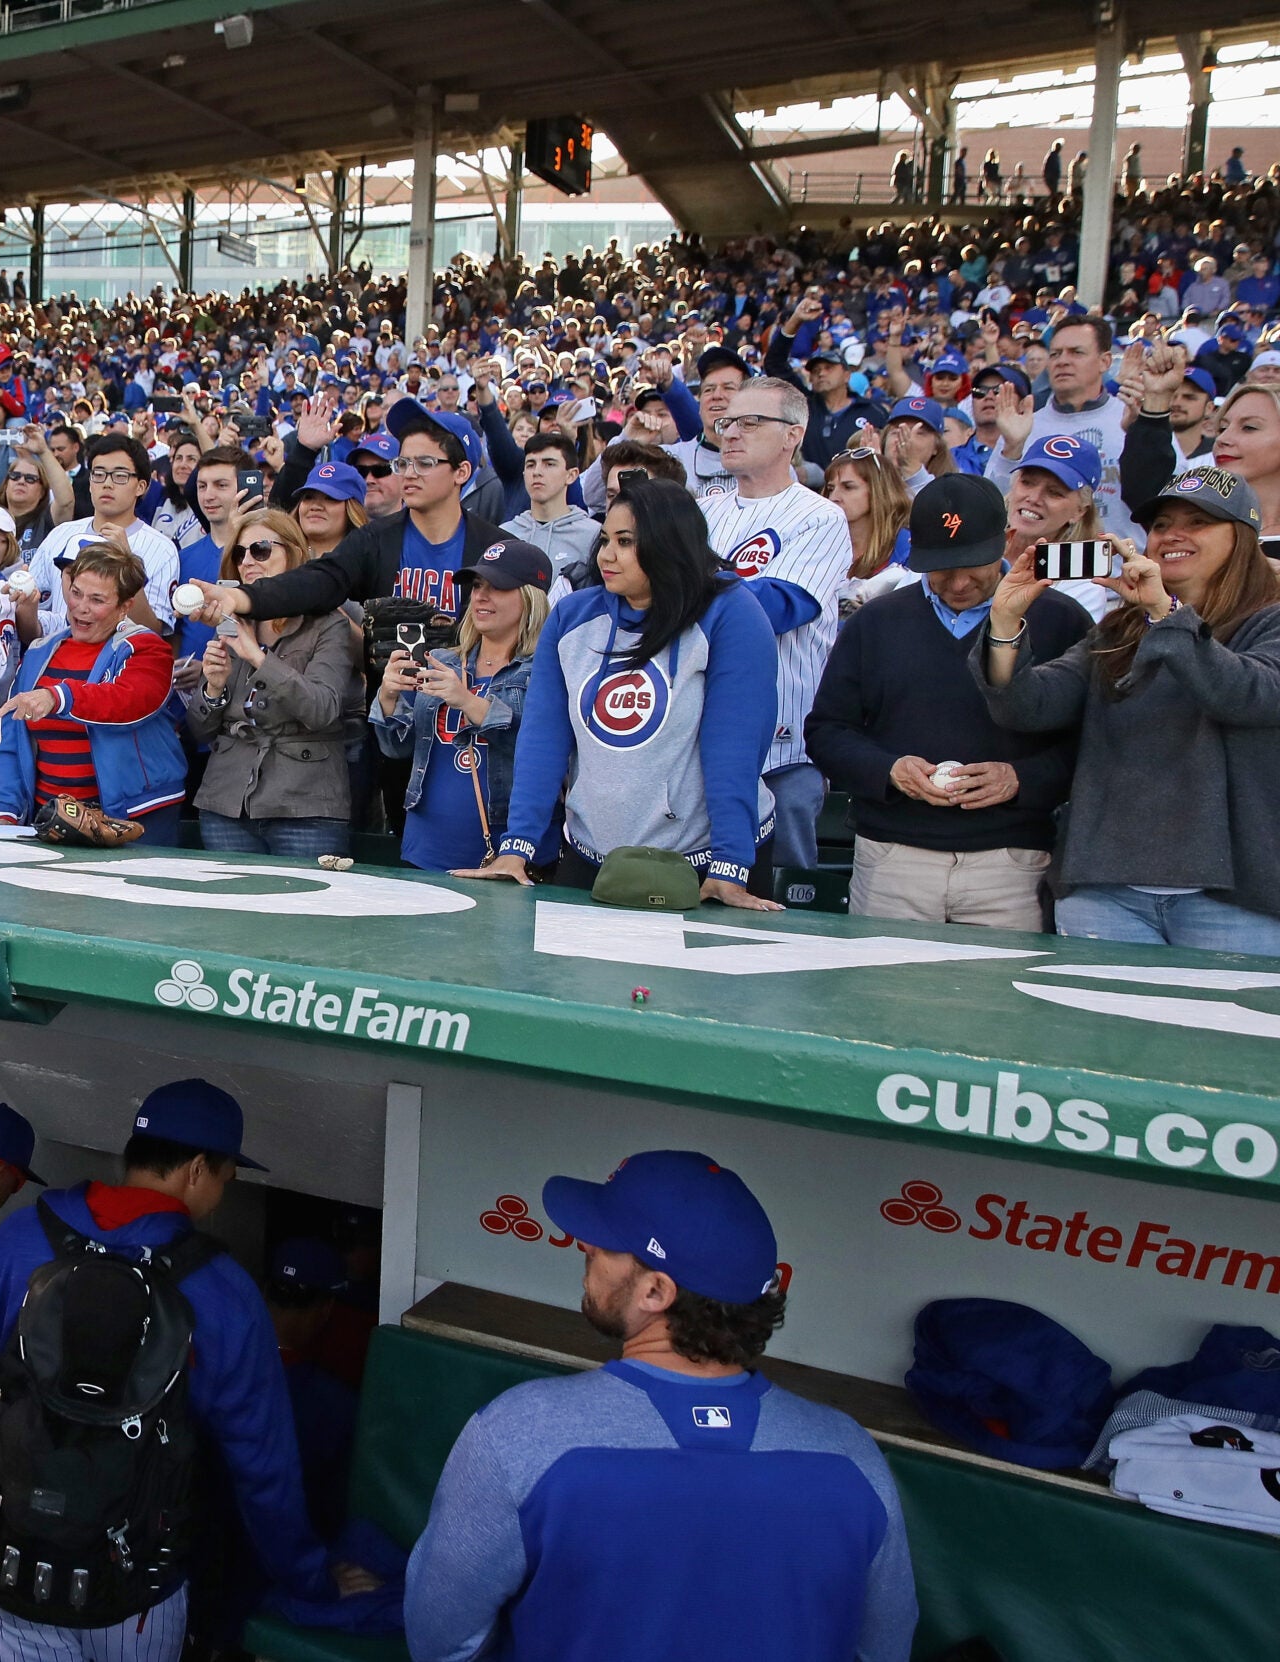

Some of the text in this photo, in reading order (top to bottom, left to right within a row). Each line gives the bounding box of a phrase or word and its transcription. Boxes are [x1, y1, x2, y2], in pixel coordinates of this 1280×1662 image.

[1043, 435, 1081, 459] C
[592, 670, 652, 731] CUBS
[711, 860, 739, 878] CUBS
[789, 887, 813, 900] 106
[875, 1071, 1280, 1179] cubs.co
